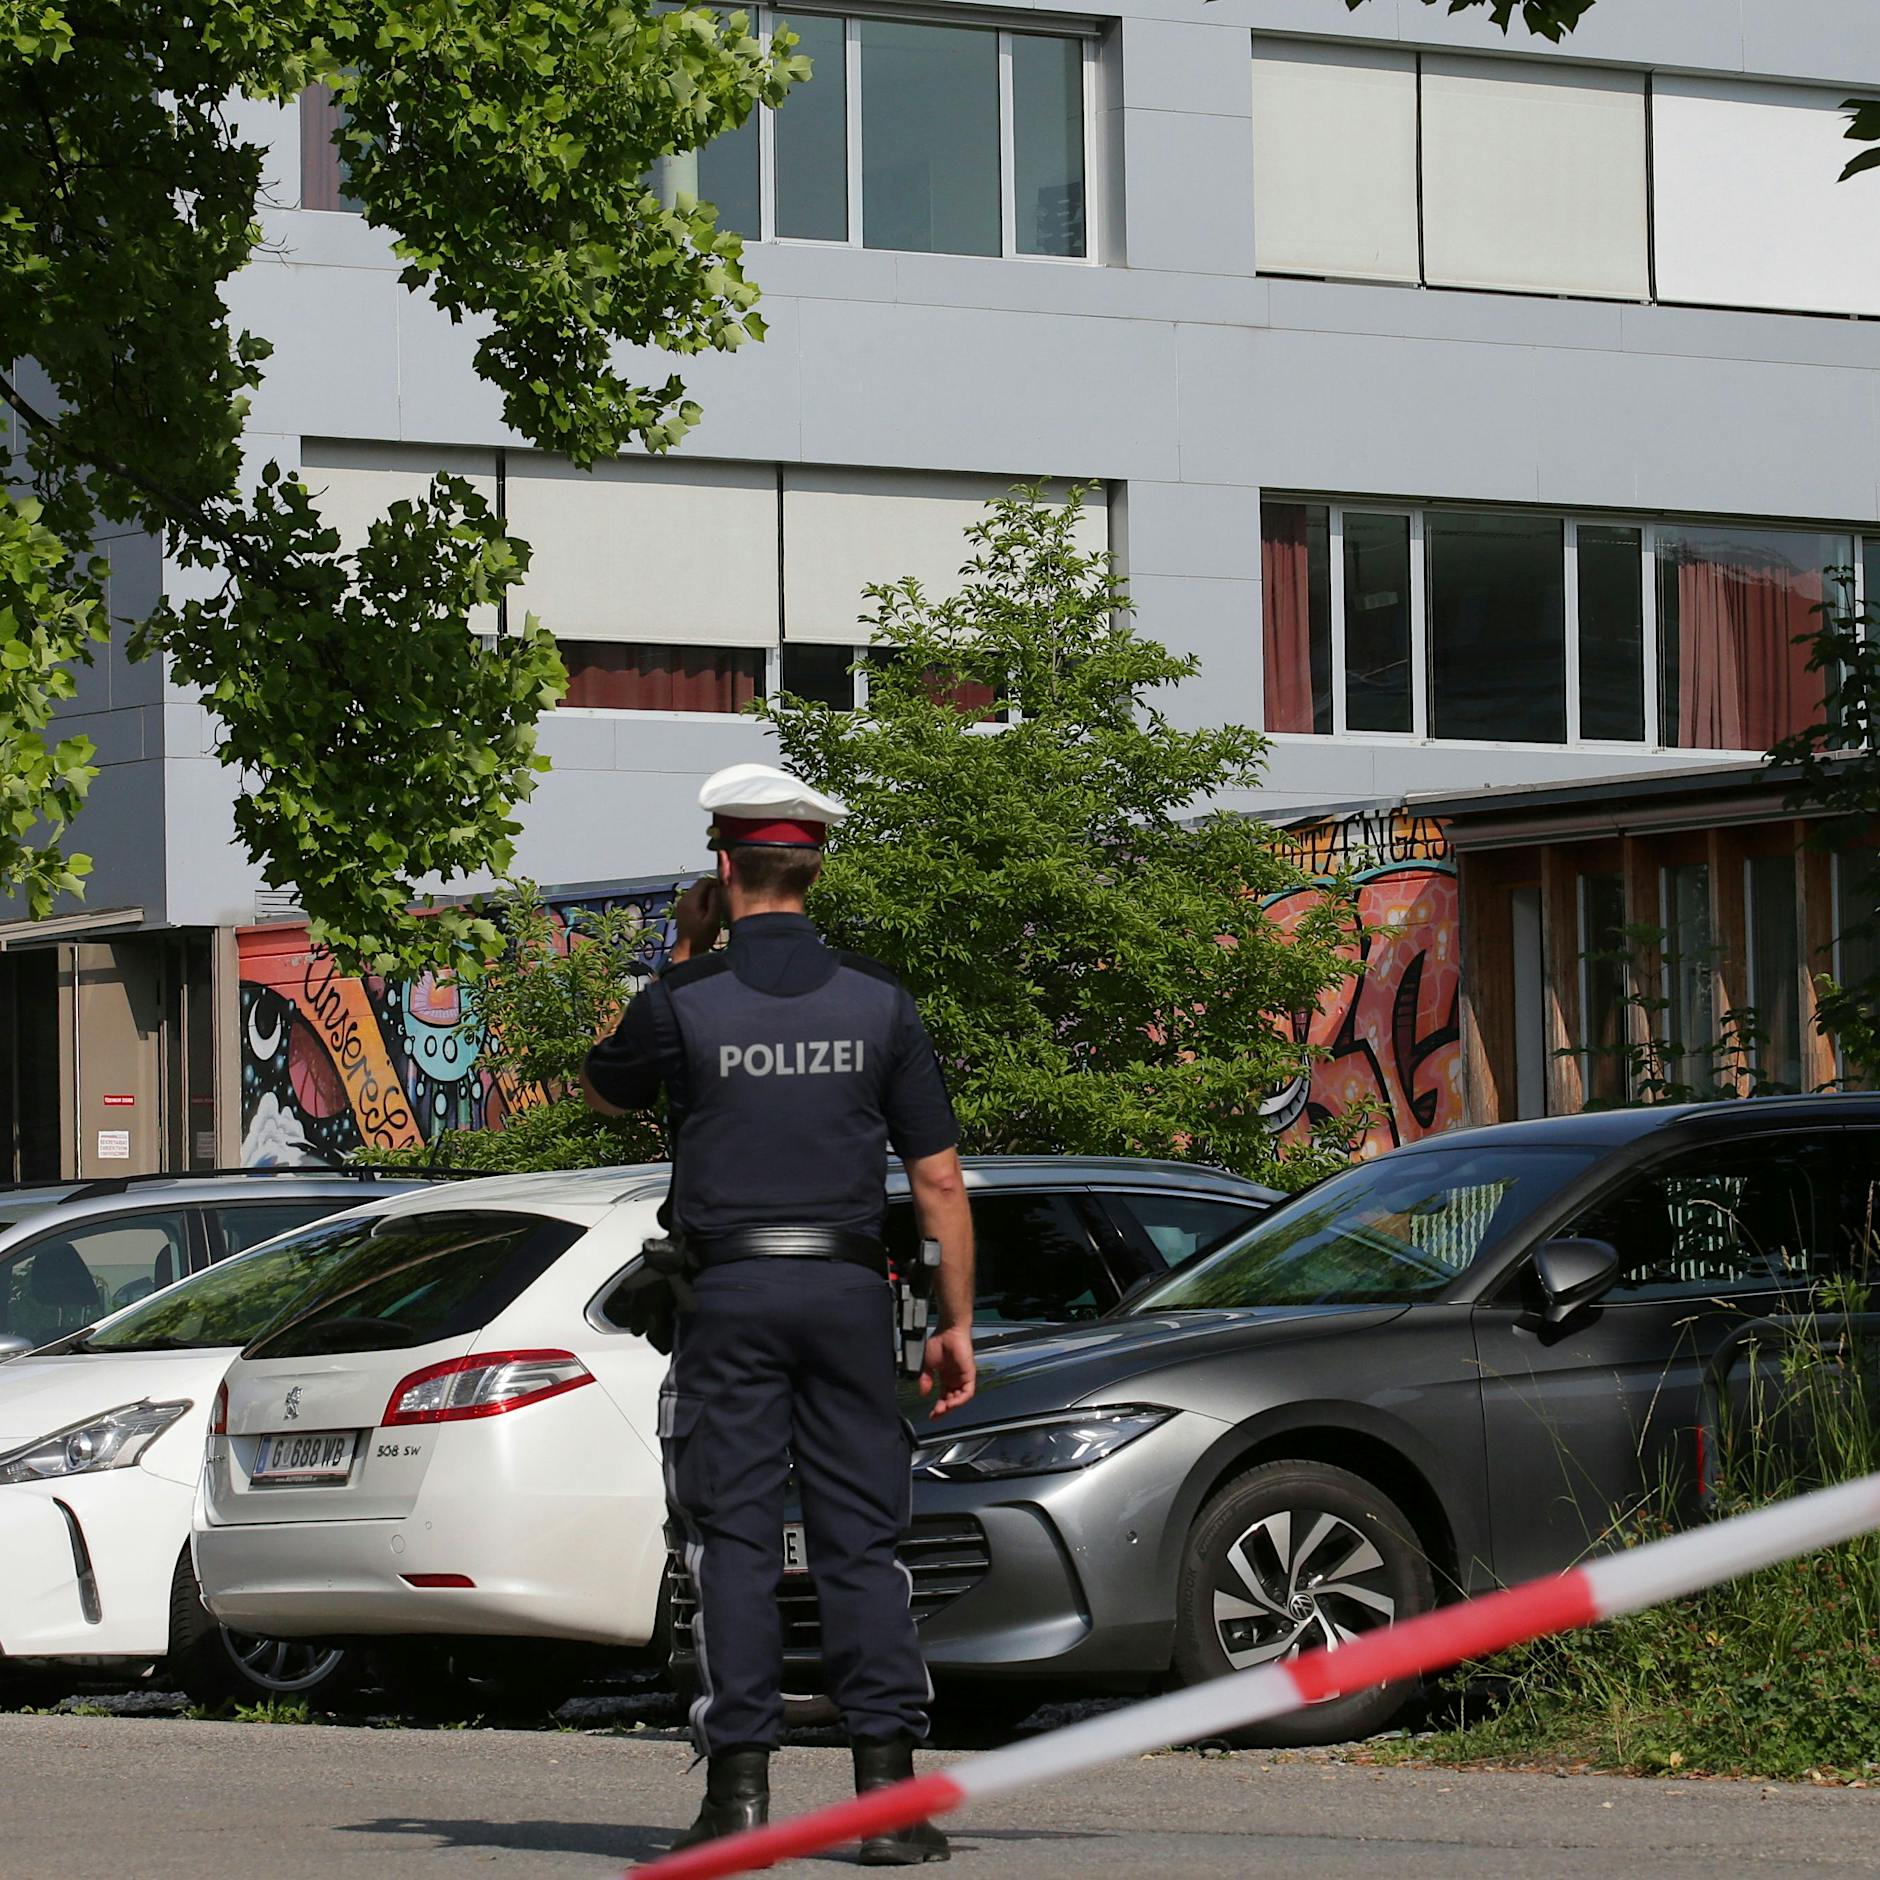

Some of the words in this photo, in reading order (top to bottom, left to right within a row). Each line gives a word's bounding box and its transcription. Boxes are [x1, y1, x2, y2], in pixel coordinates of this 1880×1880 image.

[719, 1040, 864, 1077] POLIZEI
[272, 1440, 282, 1468] G
[291, 1438, 321, 1468] 688
[321, 1438, 346, 1467] WB
[403, 1446, 422, 1456] SW
